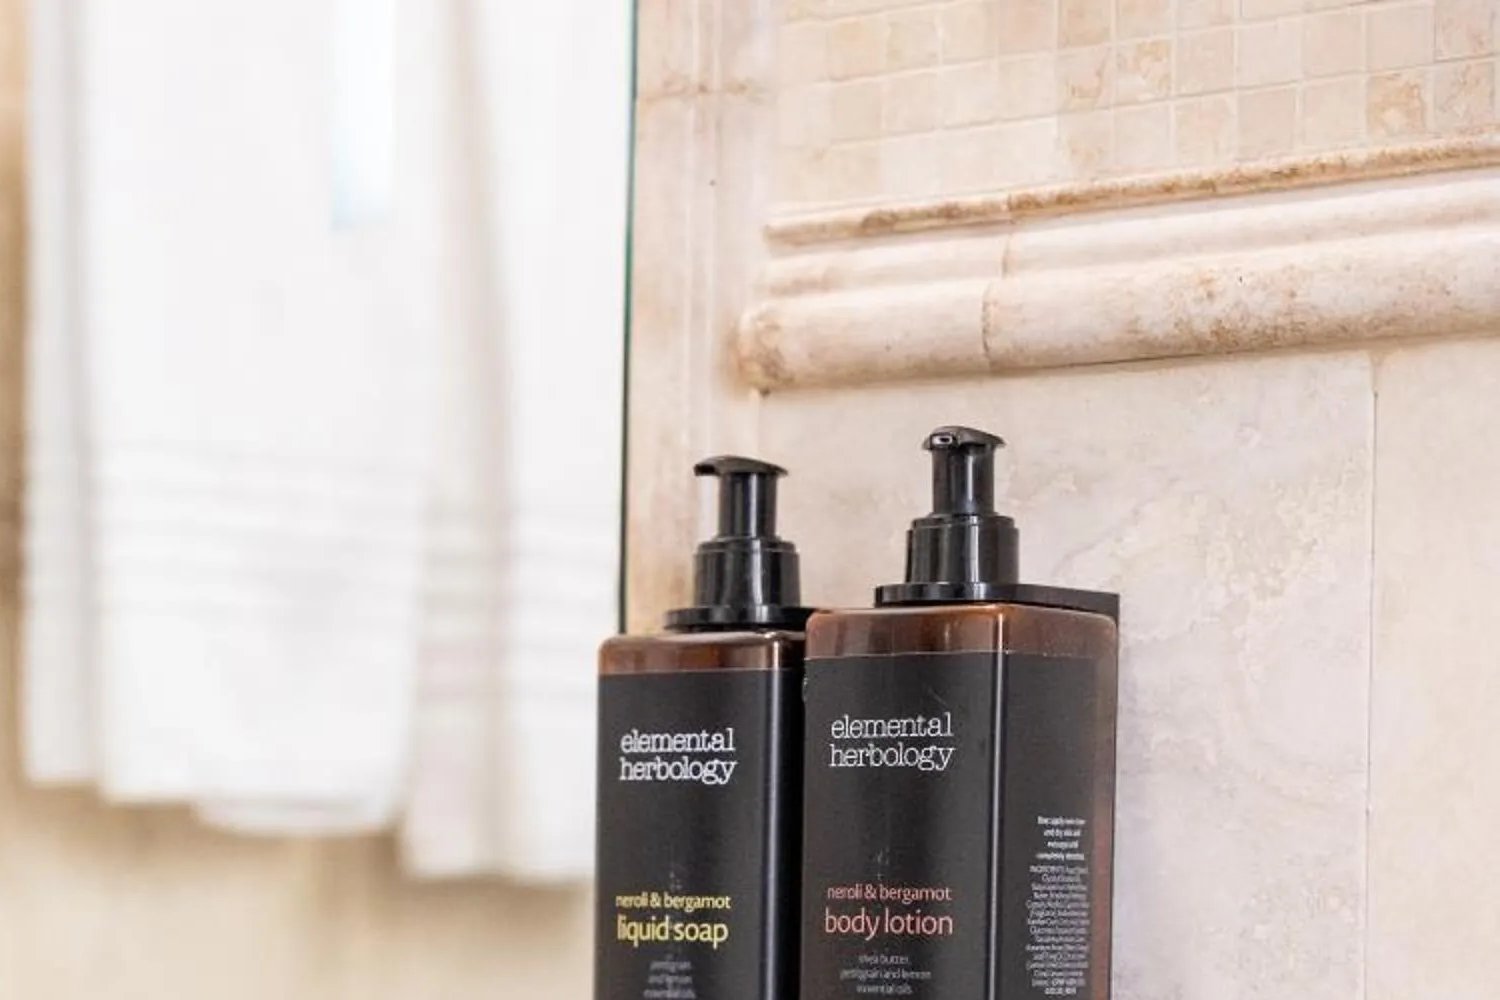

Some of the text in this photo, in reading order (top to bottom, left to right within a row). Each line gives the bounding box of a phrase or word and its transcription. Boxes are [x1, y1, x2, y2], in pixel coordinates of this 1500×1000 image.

[831, 711, 954, 739] elemental
[620, 728, 736, 753] elemental
[618, 756, 739, 785] herbology
[828, 742, 957, 771] herbology
[615, 892, 732, 913] neroli & bergamot
[827, 883, 953, 905] neroli & bergamot
[616, 914, 729, 950] liquid soap
[825, 906, 954, 941] body lotion
